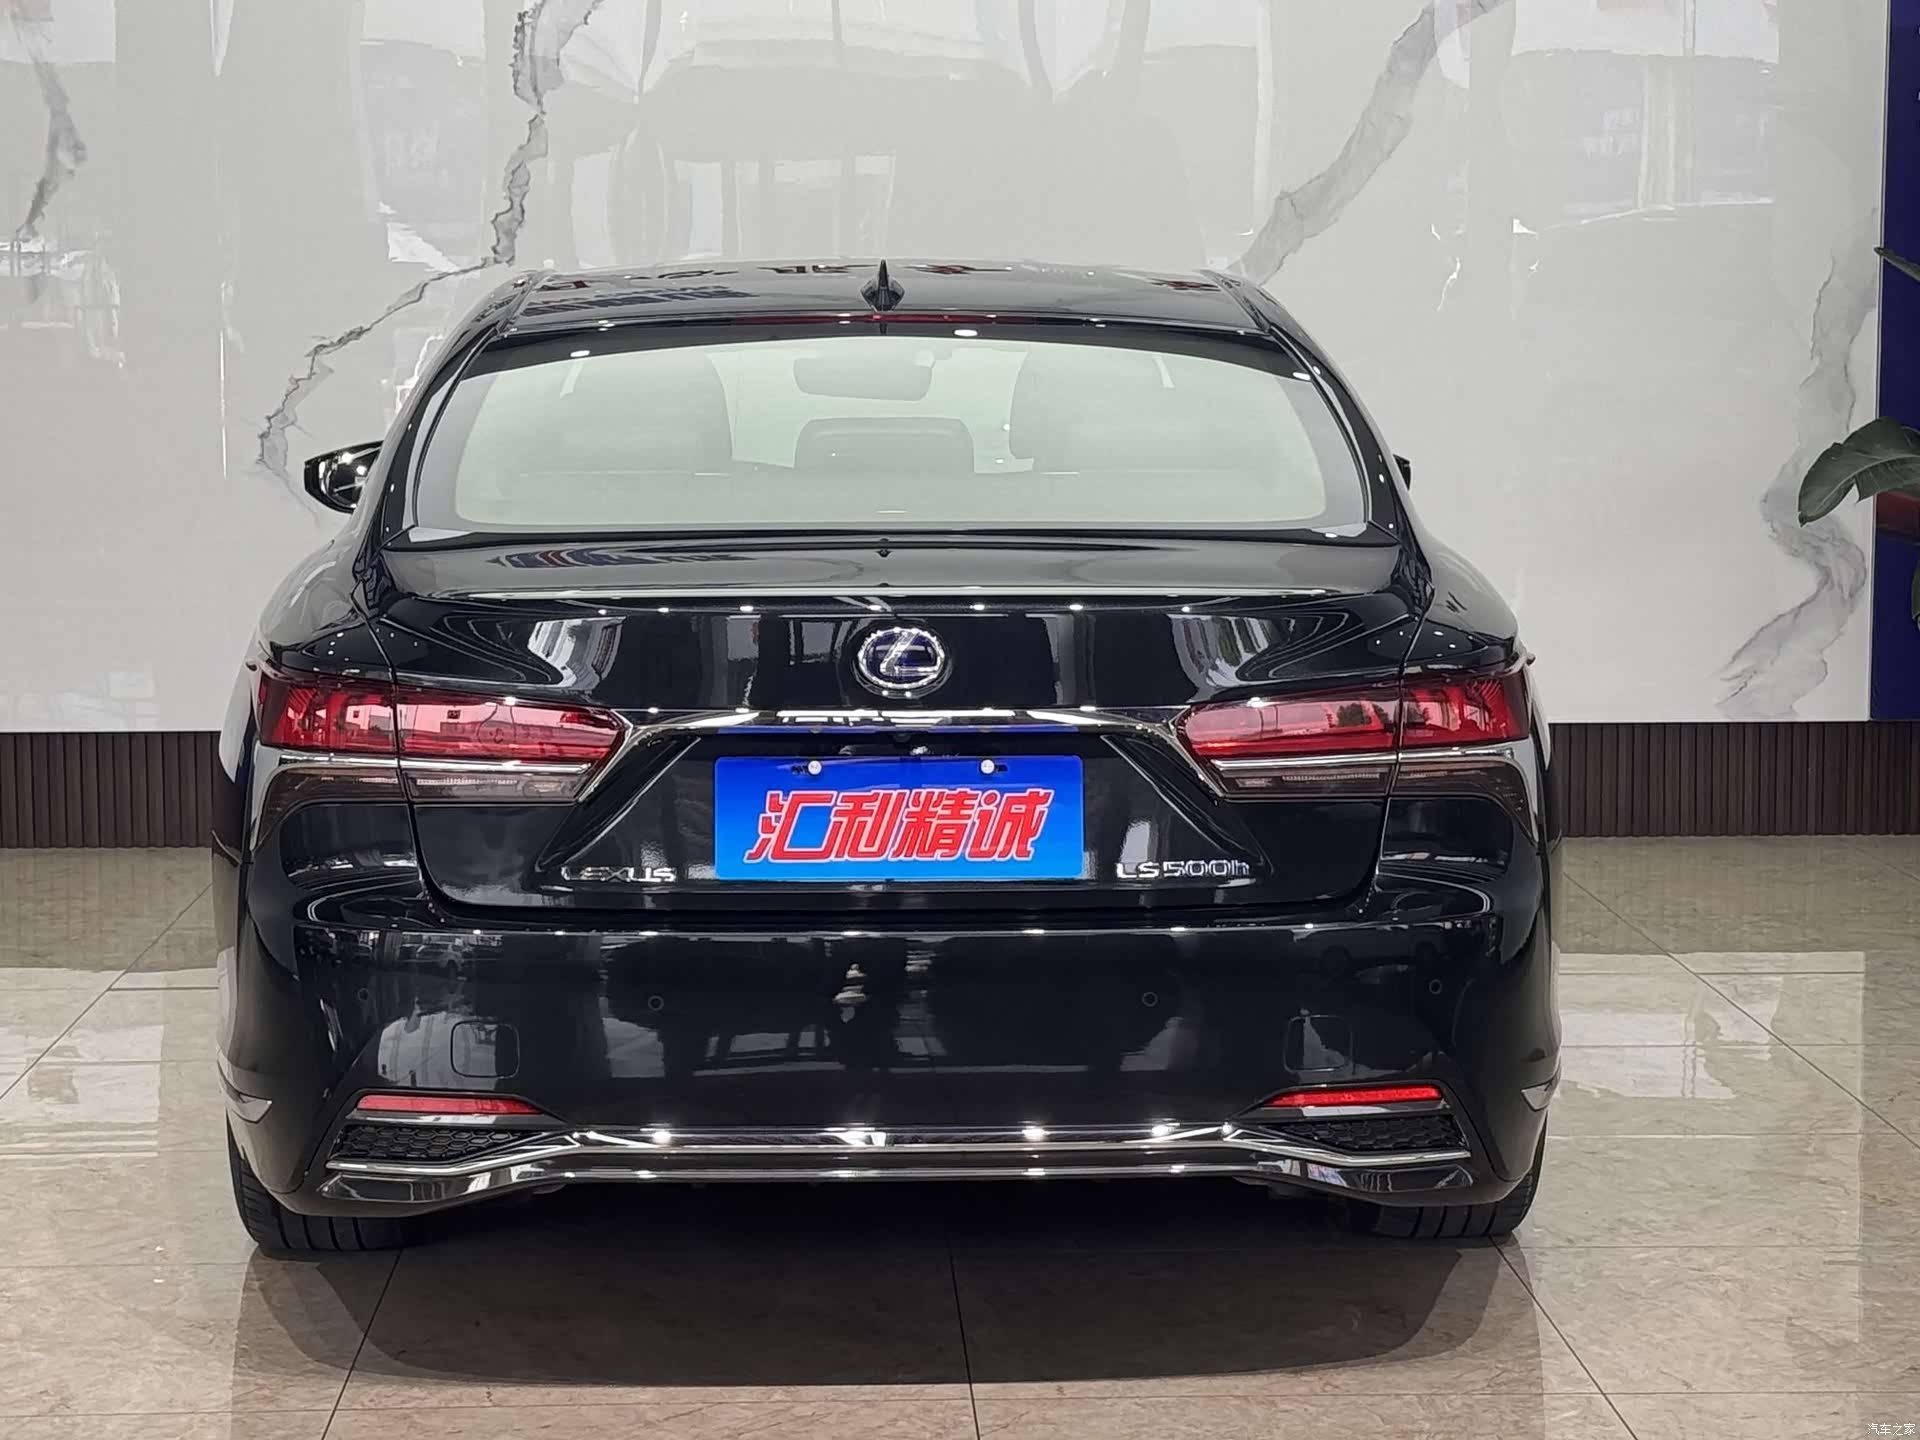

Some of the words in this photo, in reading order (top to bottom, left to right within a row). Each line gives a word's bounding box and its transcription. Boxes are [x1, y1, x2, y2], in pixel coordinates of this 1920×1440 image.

[743, 789, 1055, 863] 汇利精诚
[560, 866, 677, 882] LEXUS
